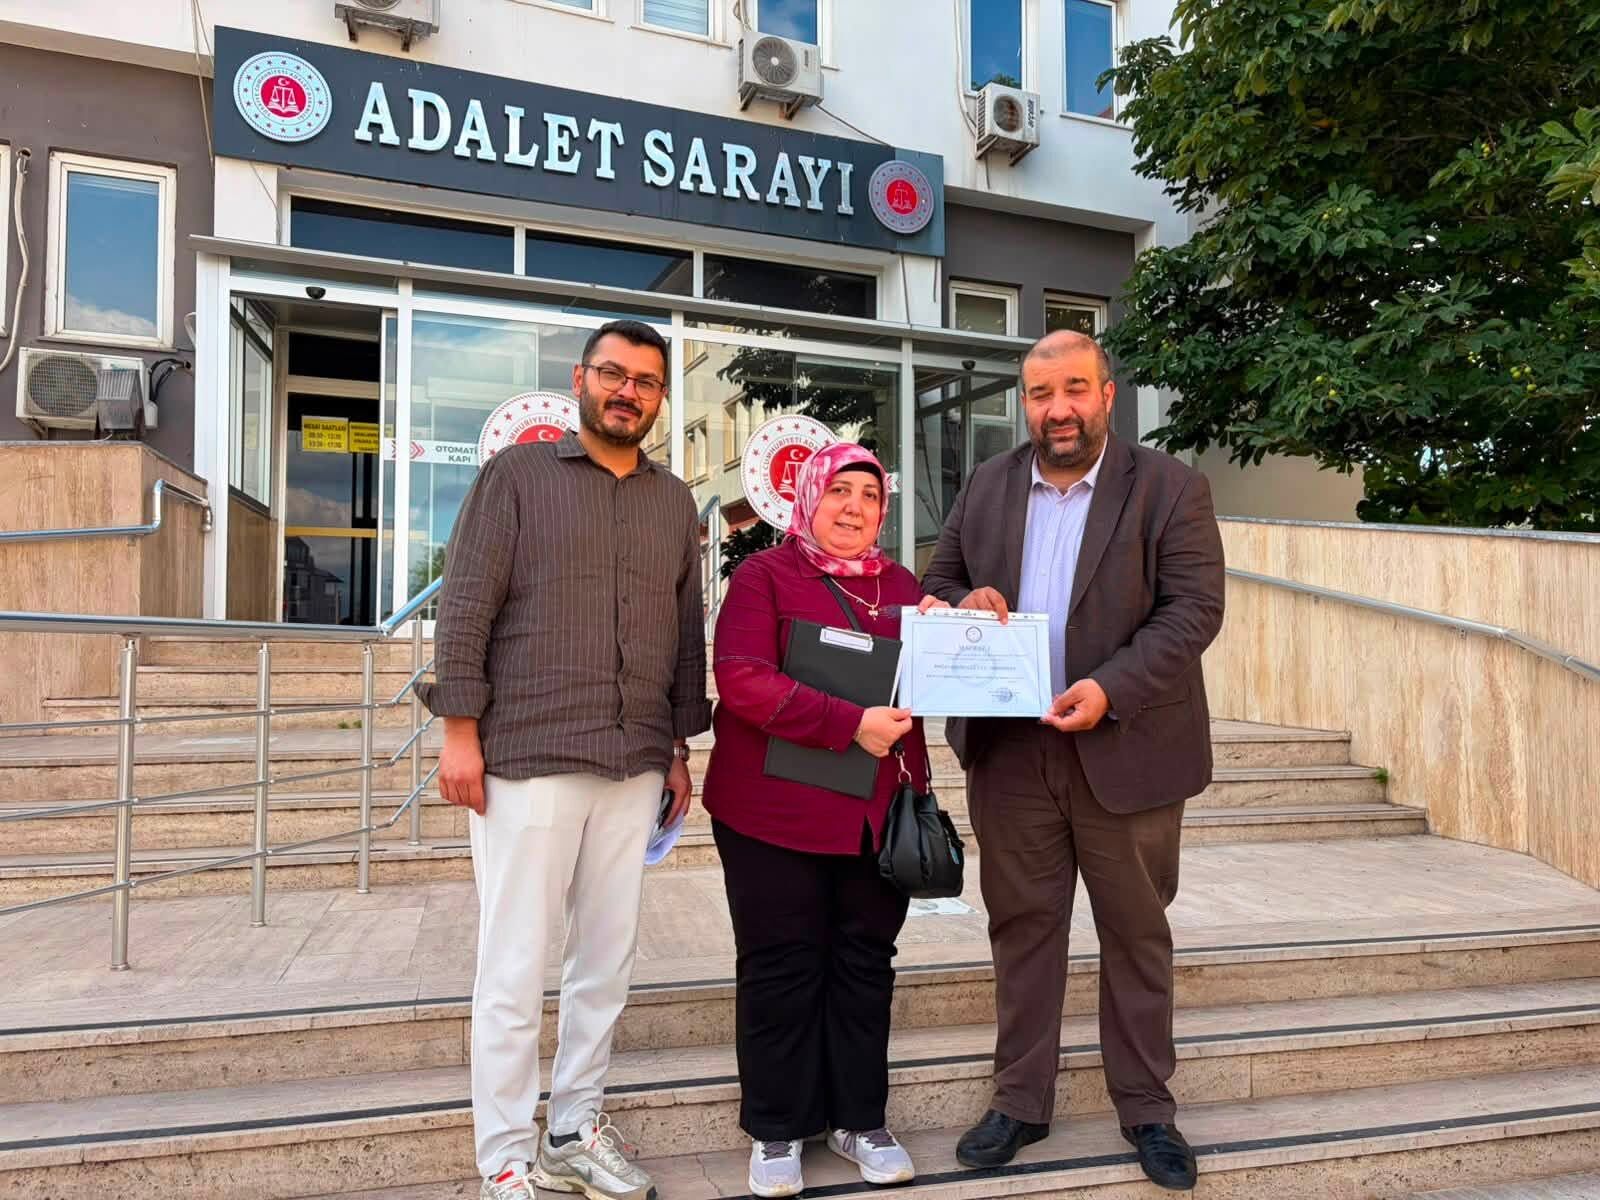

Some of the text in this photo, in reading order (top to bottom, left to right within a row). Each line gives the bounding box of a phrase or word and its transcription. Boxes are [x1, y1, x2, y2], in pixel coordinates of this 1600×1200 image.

[354, 81, 625, 180] ADALET
[643, 128, 855, 216] SARAYI
[506, 415, 552, 446] UMHURİYETİ
[435, 445, 478, 455] OTOMATİ
[448, 455, 471, 463] KAPI
